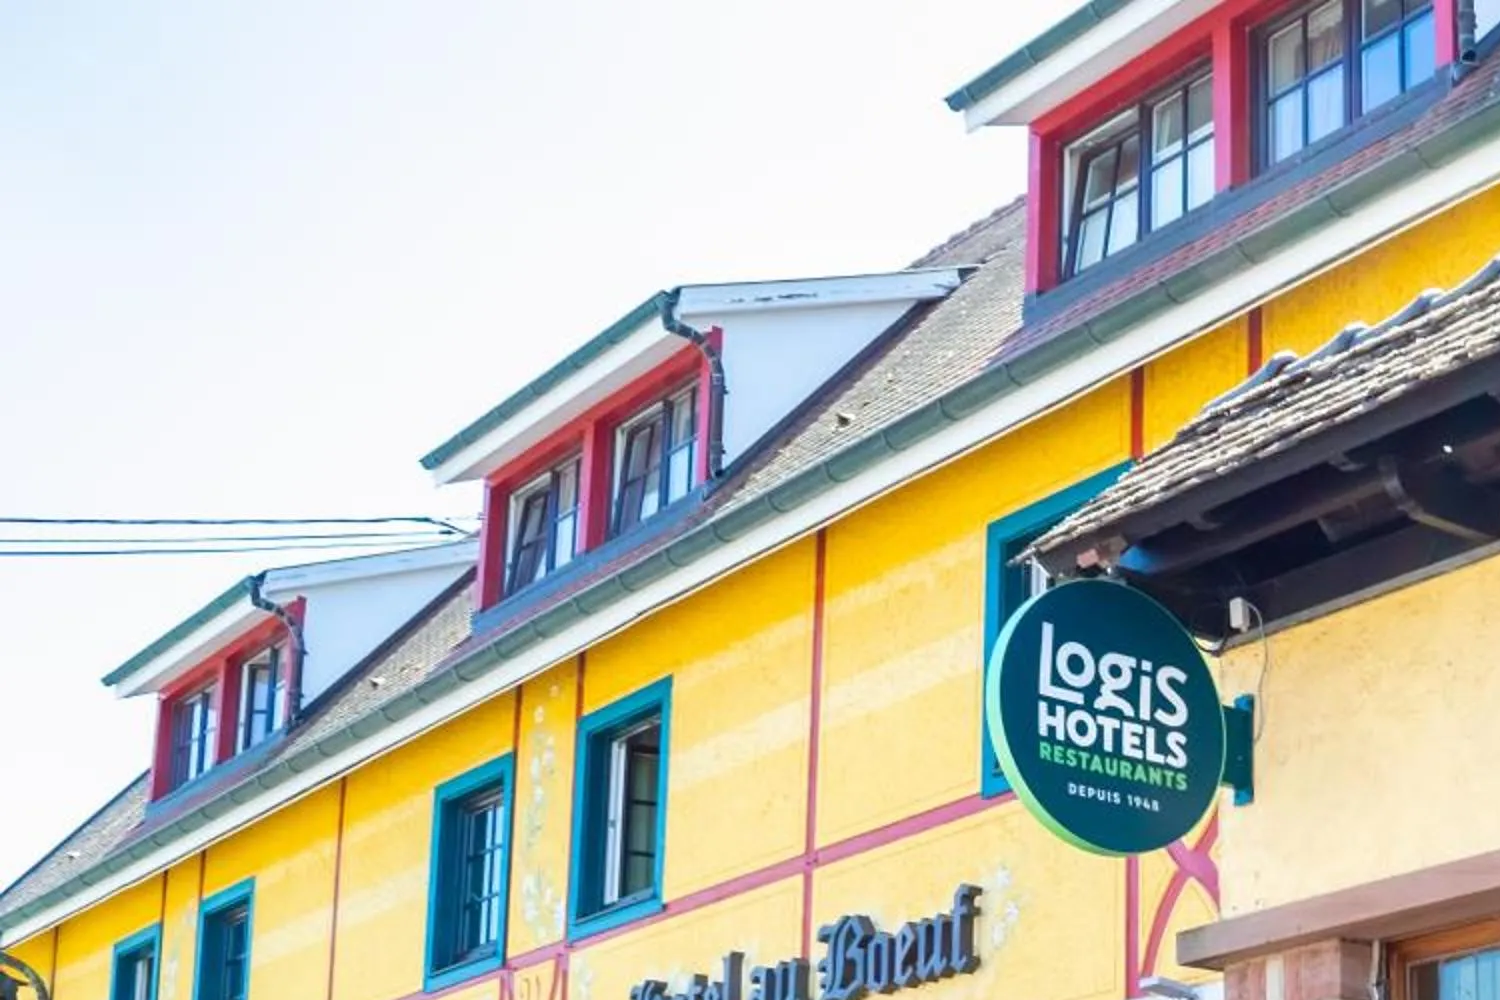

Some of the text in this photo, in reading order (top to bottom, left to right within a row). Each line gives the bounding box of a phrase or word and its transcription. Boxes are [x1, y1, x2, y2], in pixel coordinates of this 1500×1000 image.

[1037, 700, 1188, 769] HOTELS
[1038, 741, 1189, 791] RESTAURANTS
[1066, 782, 1160, 812] DEPUIS 1948
